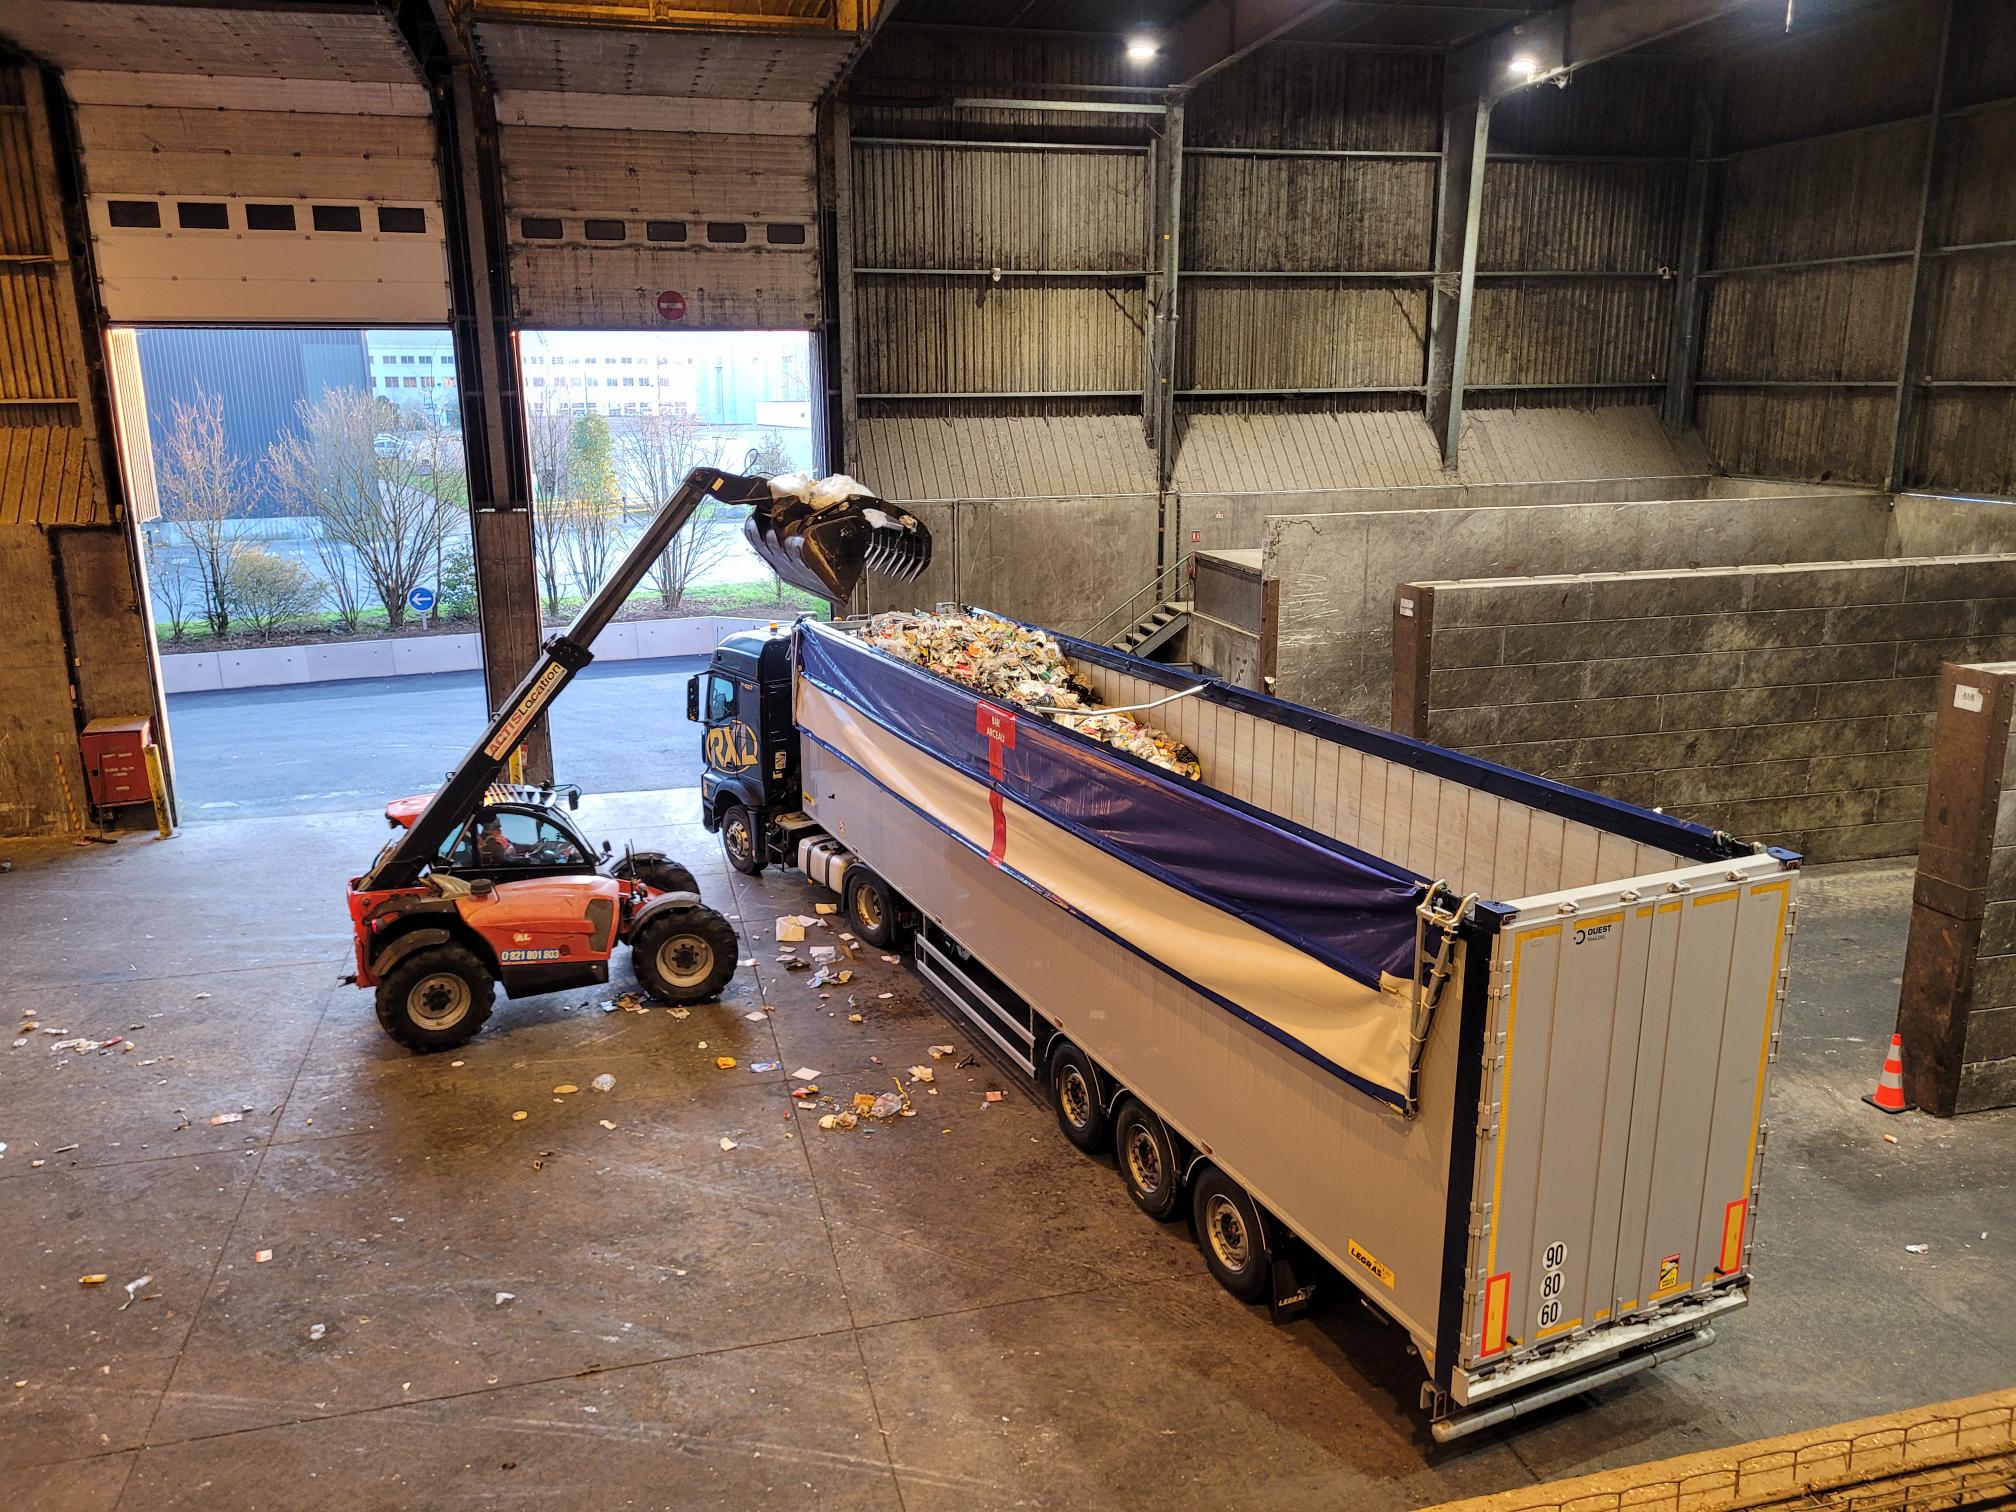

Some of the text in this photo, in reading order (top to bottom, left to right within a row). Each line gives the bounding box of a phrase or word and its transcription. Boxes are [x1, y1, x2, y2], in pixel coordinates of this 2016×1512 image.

[709, 723, 759, 769] RXL
[1587, 925, 1612, 935] OUEST
[510, 950, 525, 960] 821
[1351, 1247, 1382, 1277] LEGRAS
[1546, 1244, 1564, 1269] 90
[1543, 1273, 1561, 1296] 80
[1541, 1301, 1558, 1325] 60
